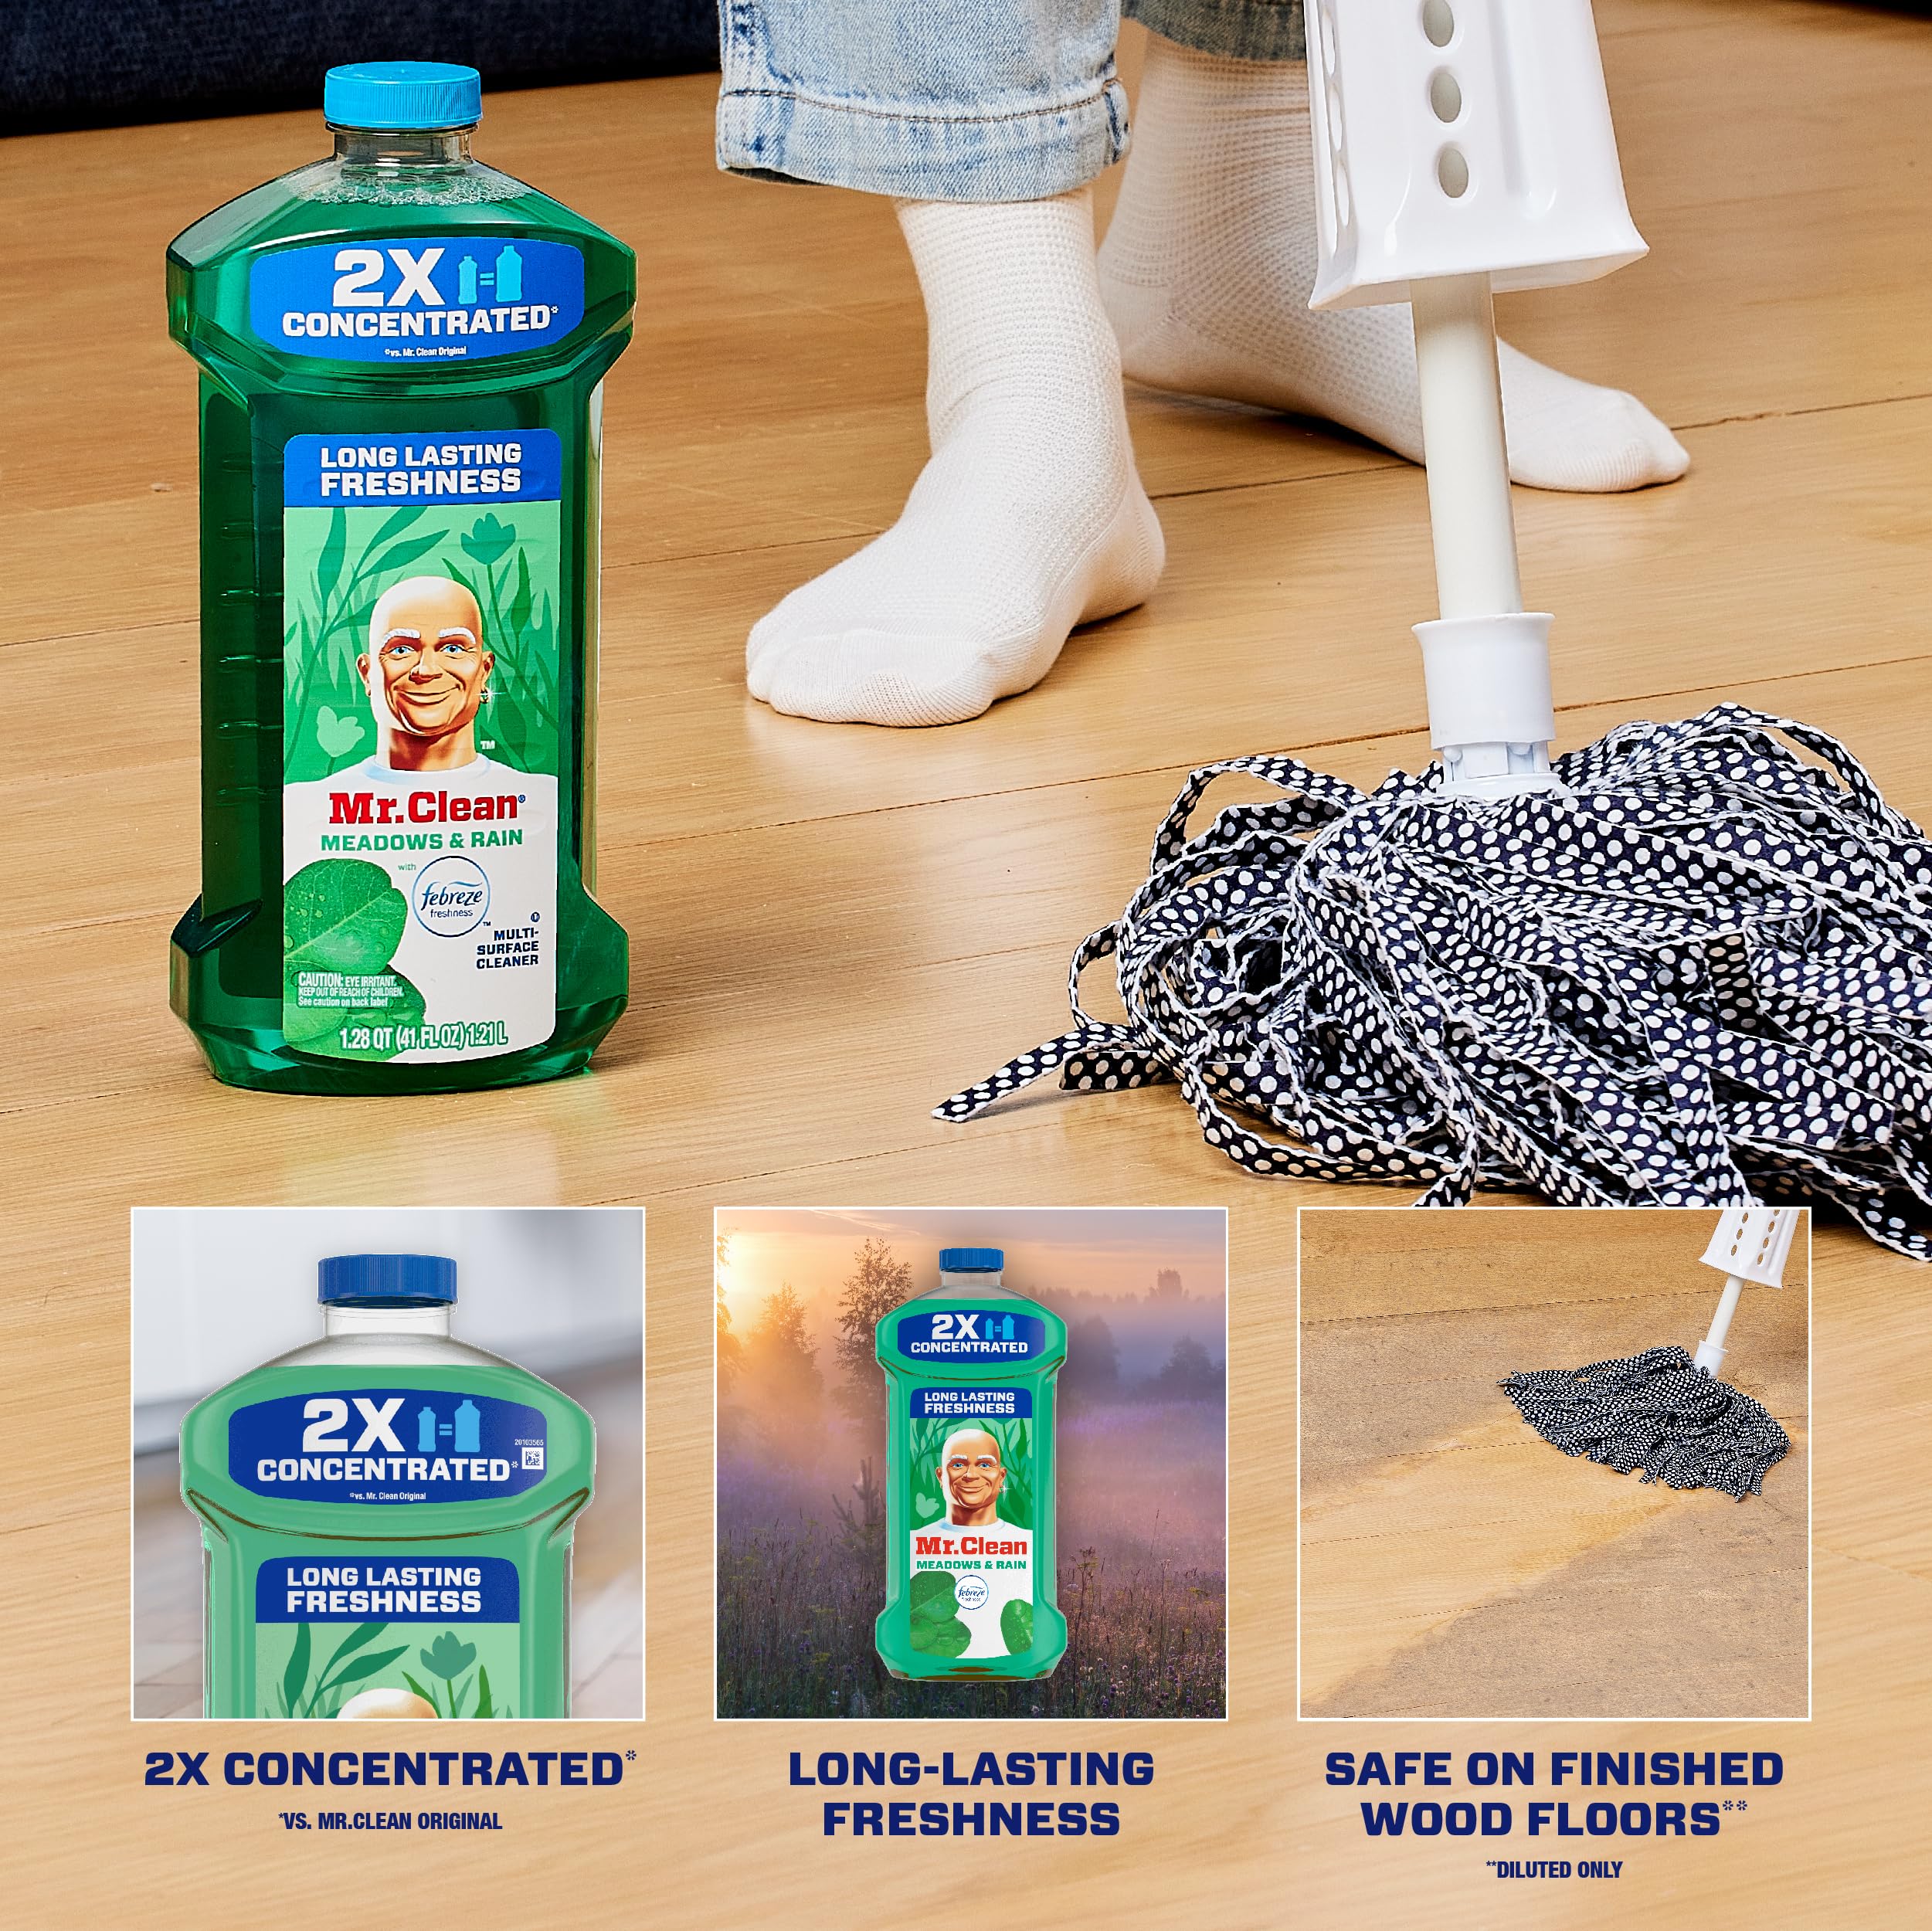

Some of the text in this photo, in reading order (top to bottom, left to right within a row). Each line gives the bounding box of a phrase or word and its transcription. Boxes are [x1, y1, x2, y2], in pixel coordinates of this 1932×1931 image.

[333, 248, 445, 307] 2X
[402, 348, 415, 356] Mr.
[416, 347, 437, 356] Clean
[438, 345, 467, 356] Original
[321, 443, 521, 468] LONG LASTING
[321, 468, 521, 497] FRESHNESS
[321, 829, 522, 851] MEADOWS & RAIN
[421, 881, 483, 911] febreze
[430, 908, 473, 918] freshness
[494, 928, 538, 941] MULTI-
[477, 941, 538, 955] SURFACE
[477, 955, 538, 969] CLEANER
[298, 972, 397, 987] CAUTION: EYE IRRITANT.
[299, 986, 404, 997] KEEP OUT OF REACH OF CHILDREN.
[299, 996, 312, 1006] See
[313, 998, 340, 1006] caution
[351, 998, 369, 1006] back
[370, 997, 389, 1007] label
[340, 1021, 508, 1050] 1.28 QT (41 FL OZ) 1.21 L
[932, 1314, 980, 1340] 2X
[911, 1342, 1028, 1353] CONCENTRATED
[925, 1392, 1015, 1402] LONG LASTING
[924, 1403, 1015, 1413] FRESHNESS
[302, 1398, 406, 1452] 2X
[379, 1492, 399, 1500] Clean
[399, 1492, 426, 1502] Original
[915, 1536, 1027, 1555] Mr.Clean
[916, 1560, 1027, 1570] MEADOWS & RAIN
[287, 1567, 481, 1587] LONG LASTING
[287, 1590, 481, 1613] FRESHNESS
